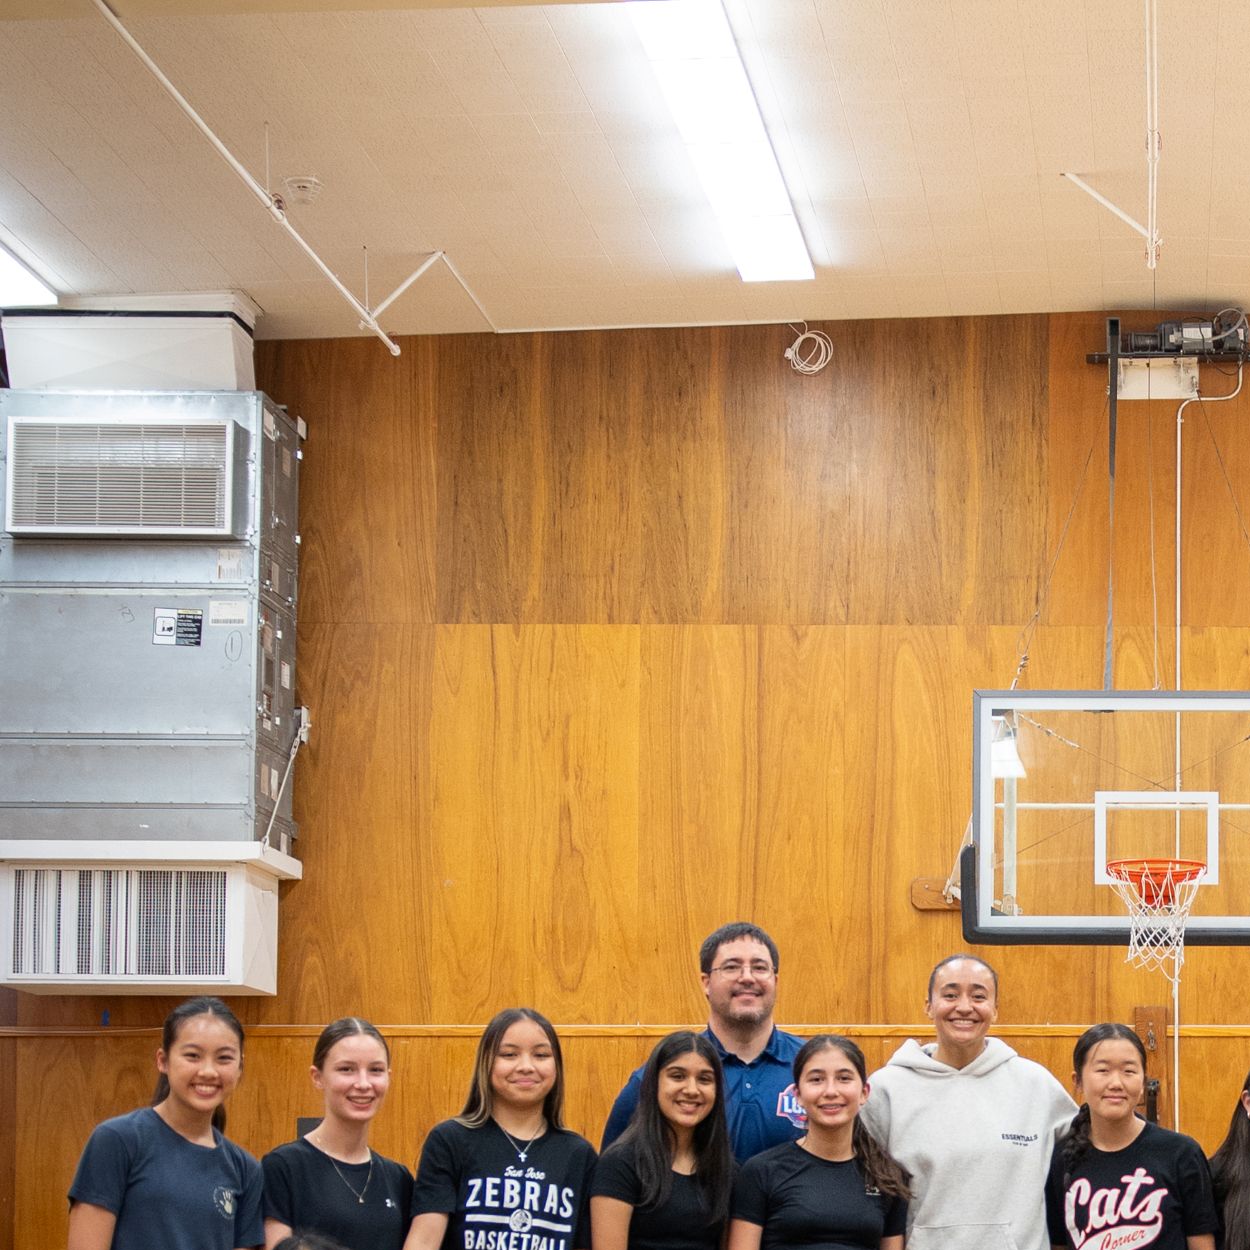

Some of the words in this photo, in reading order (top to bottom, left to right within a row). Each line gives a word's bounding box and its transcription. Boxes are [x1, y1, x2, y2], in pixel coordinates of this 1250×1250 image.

[504, 1165, 523, 1177] San
[525, 1167, 546, 1180] Jose
[465, 1177, 575, 1218] ZEBRAS
[1065, 1167, 1169, 1250] Cats
